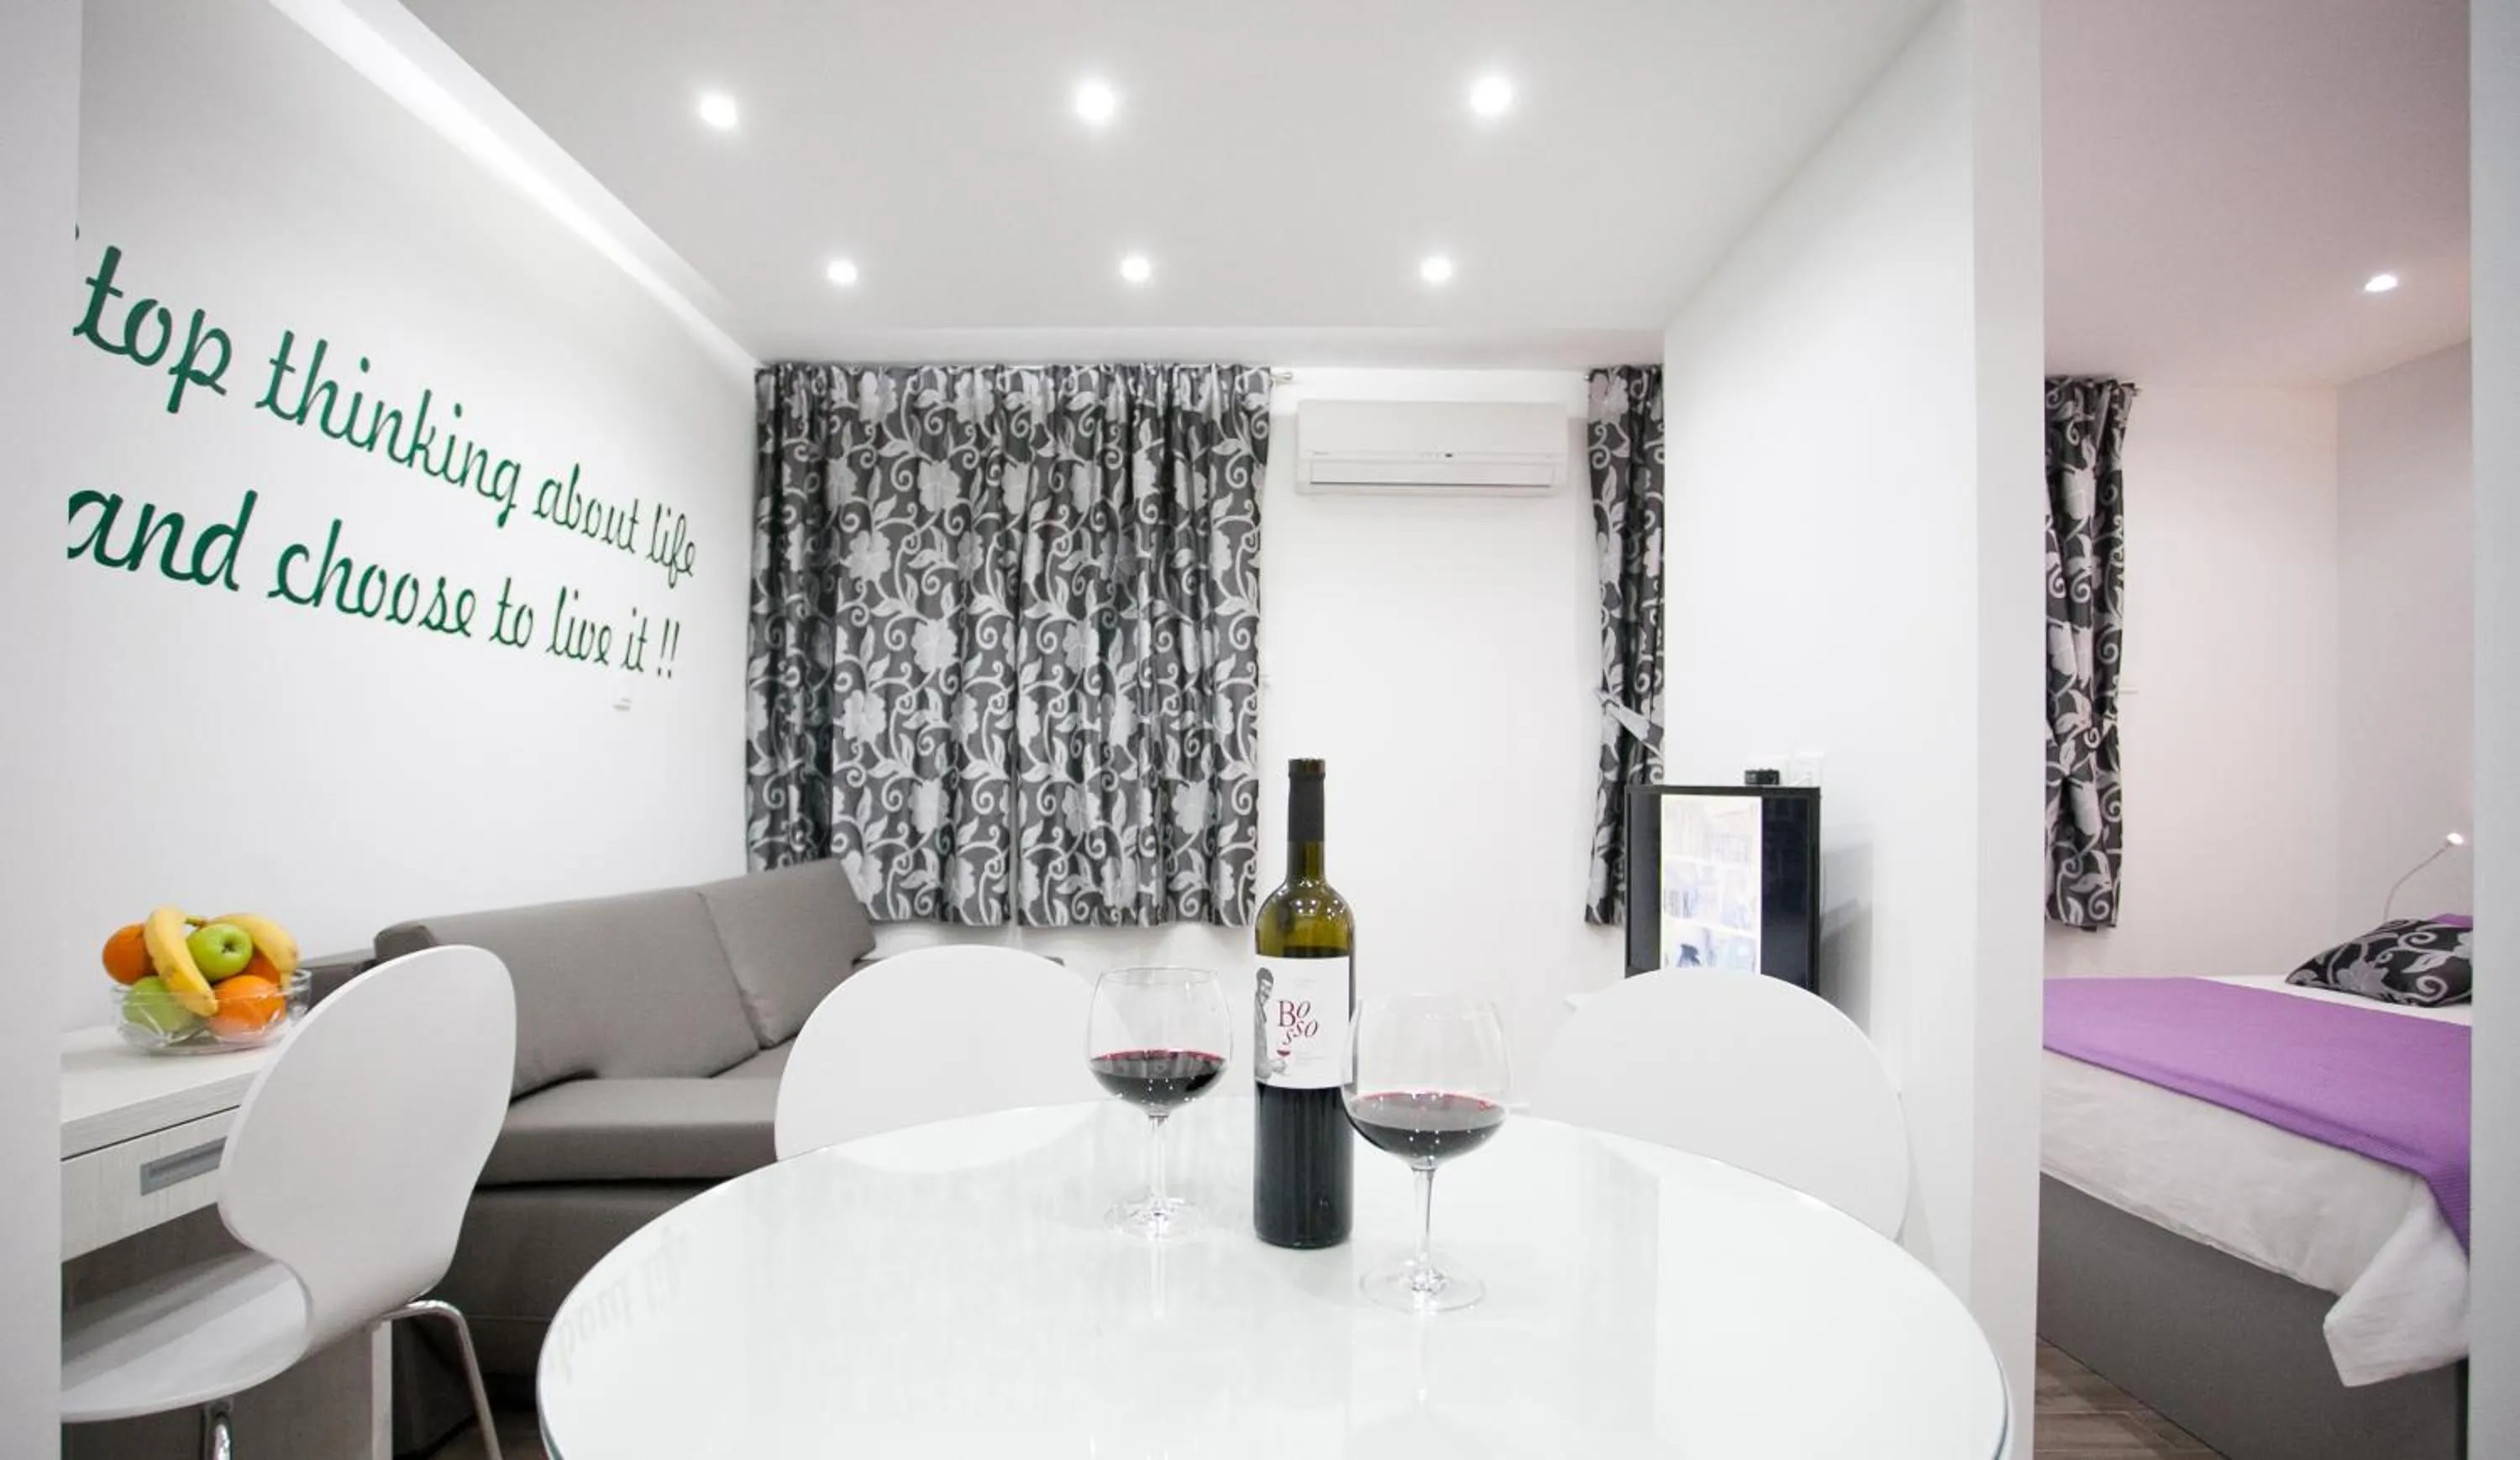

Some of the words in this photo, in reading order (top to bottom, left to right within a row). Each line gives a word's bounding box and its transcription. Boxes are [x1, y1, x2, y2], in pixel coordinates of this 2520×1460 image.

[72, 223, 233, 414] top
[255, 329, 522, 528] thinking
[533, 463, 638, 554] about
[646, 502, 696, 590] life
[266, 518, 476, 638] choose
[489, 577, 533, 649] to
[546, 586, 612, 665] live
